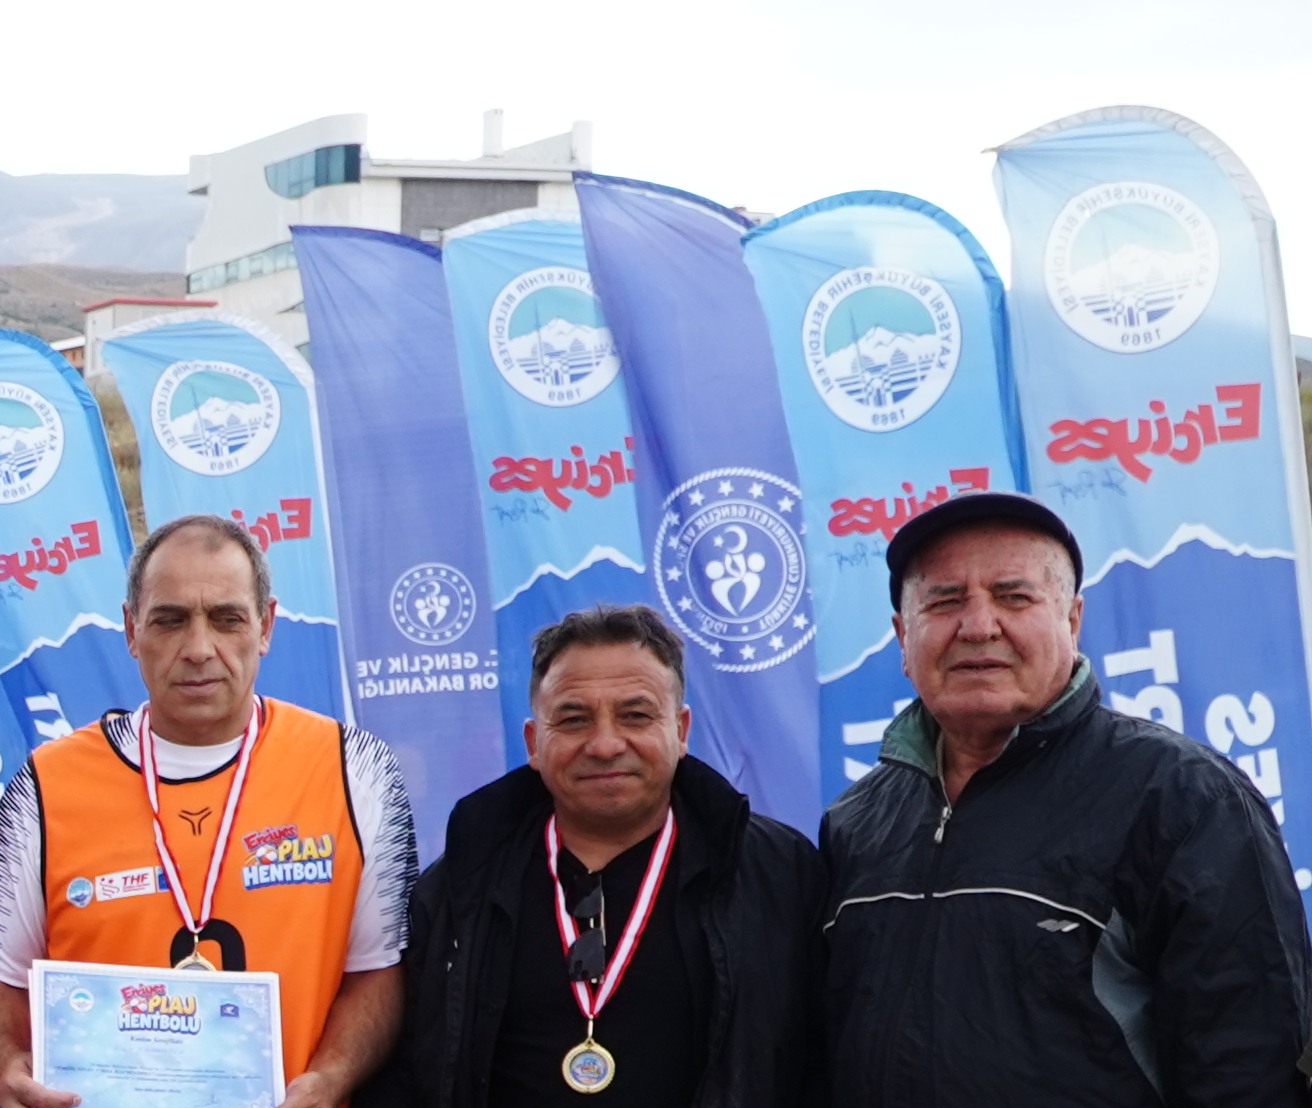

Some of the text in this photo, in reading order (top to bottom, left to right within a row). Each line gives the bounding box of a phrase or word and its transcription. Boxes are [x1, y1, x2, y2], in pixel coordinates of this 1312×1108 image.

[277, 834, 333, 863] PLAJ
[121, 872, 150, 885] THF
[146, 995, 197, 1015] PLAJ
[117, 1012, 203, 1035] HENTBOLU
